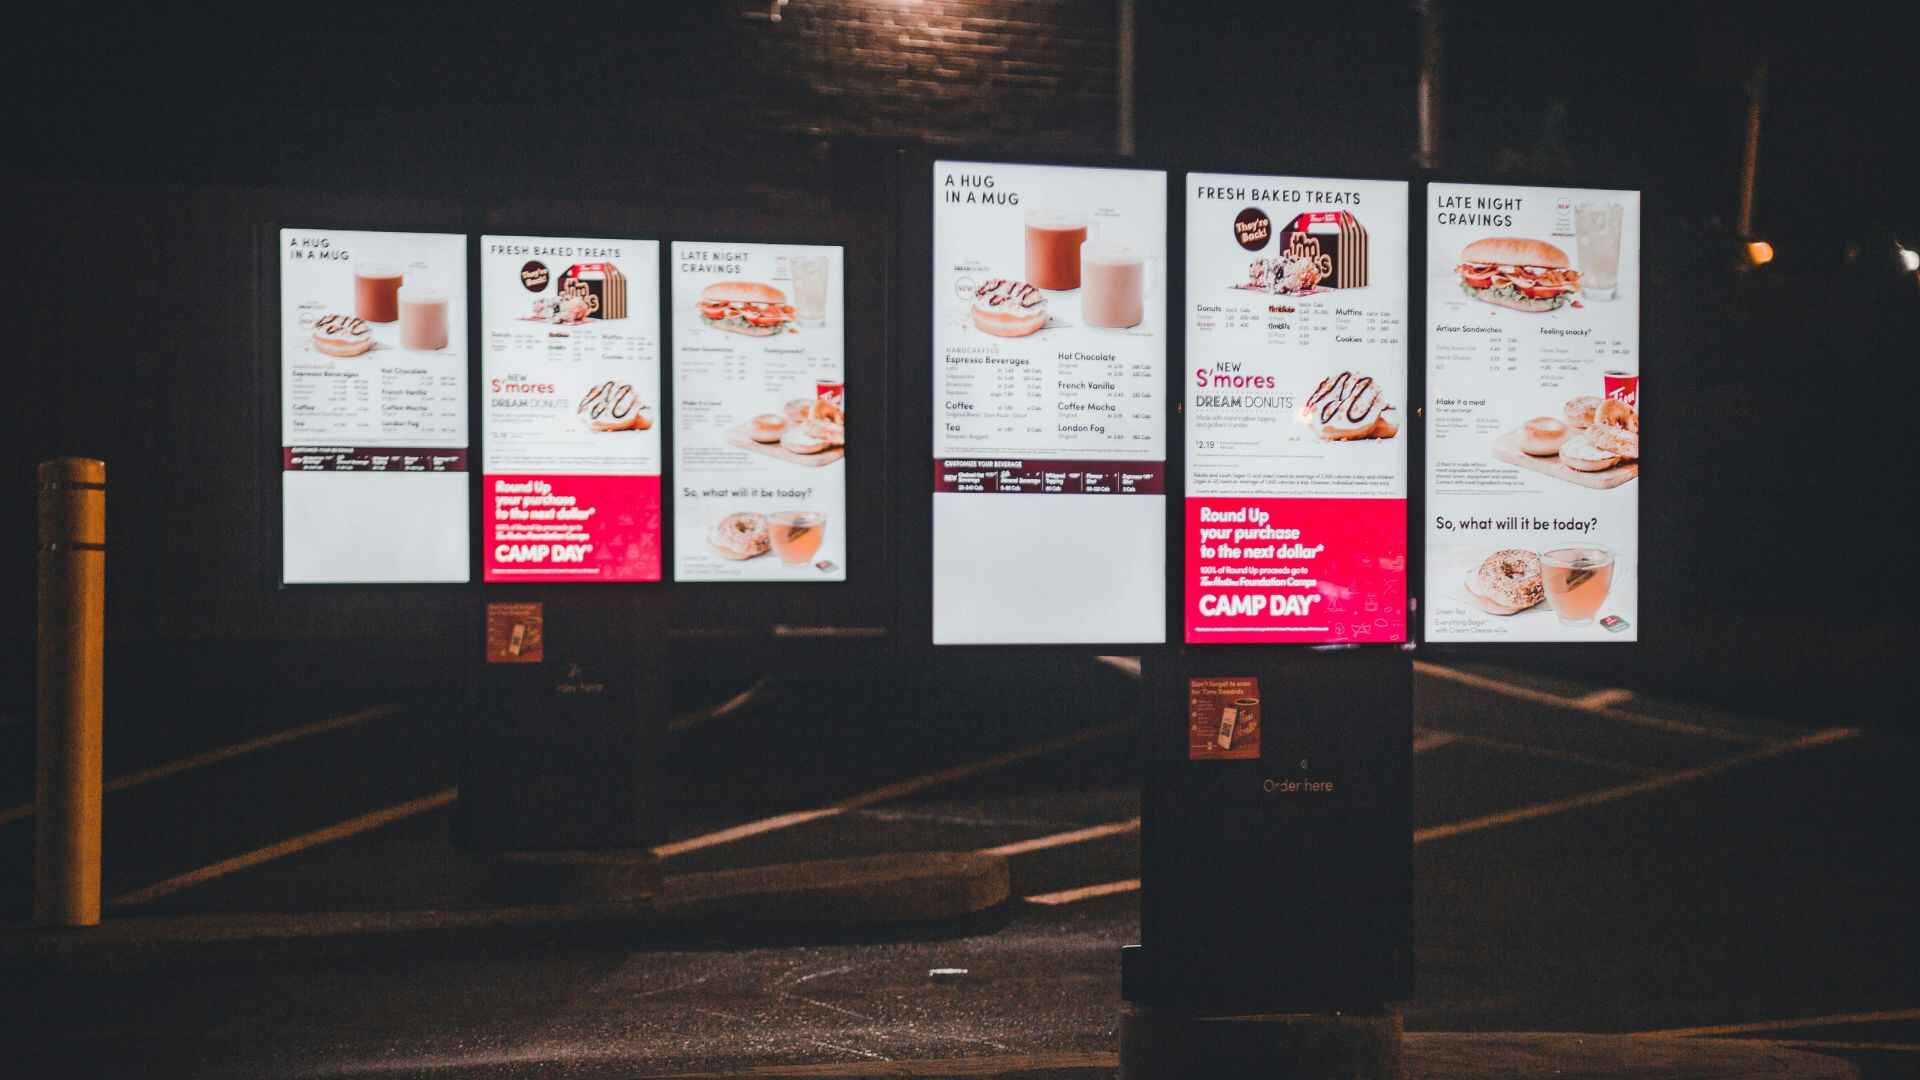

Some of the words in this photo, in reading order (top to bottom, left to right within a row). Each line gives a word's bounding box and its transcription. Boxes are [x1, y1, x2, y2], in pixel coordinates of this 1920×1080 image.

[945, 174, 954, 187] A
[961, 175, 995, 188] HUG
[946, 191, 960, 204] IN
[966, 192, 976, 204] A
[982, 192, 1019, 205] MUG
[1198, 186, 1245, 200] FRESH
[1252, 188, 1300, 202] BAKED
[1305, 191, 1361, 205] TREATS
[1438, 196, 1472, 209] LATE
[1478, 197, 1523, 211] NIGHT
[1236, 218, 1268, 232] They're
[1438, 213, 1512, 227] CRAVINGS
[1241, 230, 1268, 242] Back!
[303, 239, 330, 248] HUG
[320, 252, 349, 260] MUG
[491, 245, 529, 255] FRESH
[534, 247, 573, 256] BAKED
[578, 248, 621, 258] TREATS
[681, 251, 711, 261] LATE
[712, 252, 748, 262] NIGHT
[681, 263, 742, 273] CRAVINGS
[1336, 308, 1362, 316] Muffins
[1462, 326, 1502, 334] Sandwiches
[1540, 328, 1564, 337] Feeling
[1566, 328, 1592, 338] snacky?
[946, 355, 984, 364] Espresso
[986, 356, 1029, 366] Beverages
[1074, 353, 1116, 361] Chocolate
[1217, 362, 1241, 372] NEW
[1196, 368, 1276, 388] S'mores
[492, 378, 555, 393] S'mores
[1058, 381, 1085, 390] French
[1088, 382, 1115, 390] Vanilla
[492, 399, 528, 408] DREAM
[945, 401, 974, 410] Coffee
[1058, 402, 1084, 410] Coffee
[1088, 403, 1116, 412] Mocha
[1196, 396, 1242, 407] DREAM
[1245, 396, 1293, 408] DONUTS
[1436, 398, 1455, 406] Make
[946, 423, 960, 432] Tea
[1090, 424, 1104, 434] Fog
[495, 480, 533, 493] Round
[534, 481, 551, 496] Up
[684, 488, 698, 498] So,
[702, 488, 728, 497] what
[732, 488, 748, 497] will
[751, 488, 758, 497] it
[761, 488, 773, 497] be
[777, 488, 812, 500] today?
[495, 496, 522, 508] your
[523, 493, 576, 508] purchase
[496, 508, 508, 520] to
[510, 507, 529, 520] the
[530, 508, 556, 520] next
[1200, 507, 1246, 522] Round
[1248, 508, 1269, 526] Up
[1436, 518, 1455, 531] So,
[1460, 518, 1491, 530] what
[1496, 518, 1517, 530] will
[1521, 518, 1529, 530] it
[1534, 518, 1549, 530] be
[1554, 518, 1598, 534] today?
[1200, 528, 1233, 543] your
[1234, 524, 1300, 543] purchase
[495, 544, 549, 562] CAMP
[1200, 544, 1215, 558] to
[1218, 544, 1241, 558] the
[1244, 545, 1274, 558] next
[1248, 566, 1258, 575] Up
[1287, 577, 1316, 588] Camps
[1199, 594, 1266, 616] CAMP
[1264, 780, 1301, 792] Order
[1304, 778, 1333, 792] here
